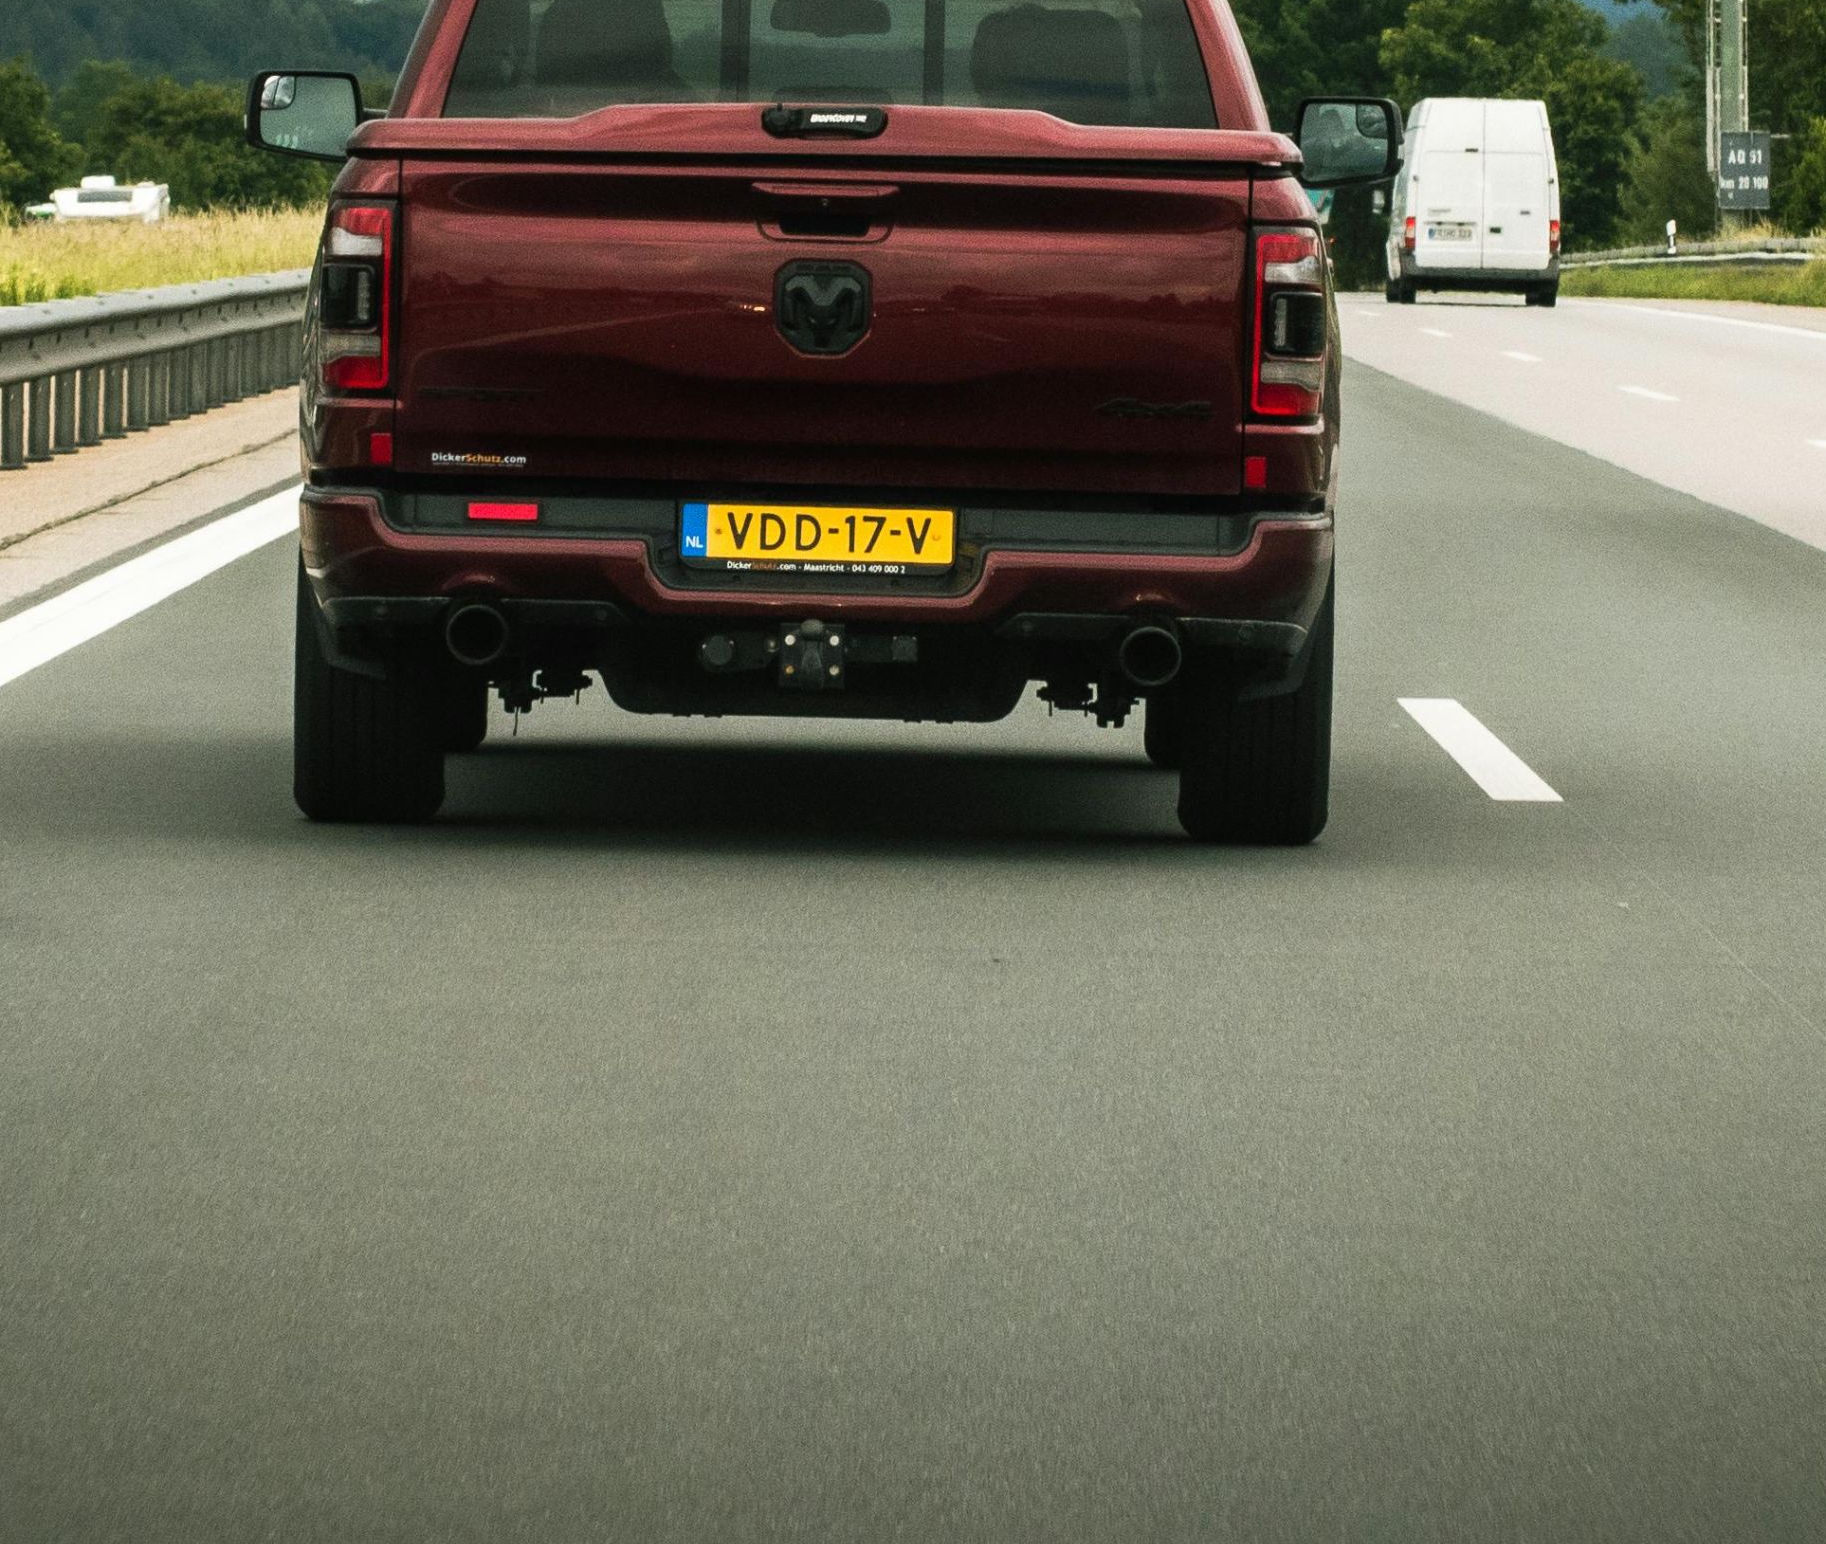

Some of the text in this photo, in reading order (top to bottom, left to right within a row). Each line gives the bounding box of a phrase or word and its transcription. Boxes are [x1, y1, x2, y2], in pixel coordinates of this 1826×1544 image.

[431, 452, 527, 464] DickerSchutz.com
[726, 511, 932, 555] VDD-17-V
[685, 536, 704, 549] NL
[803, 562, 845, 572] Maastricht
